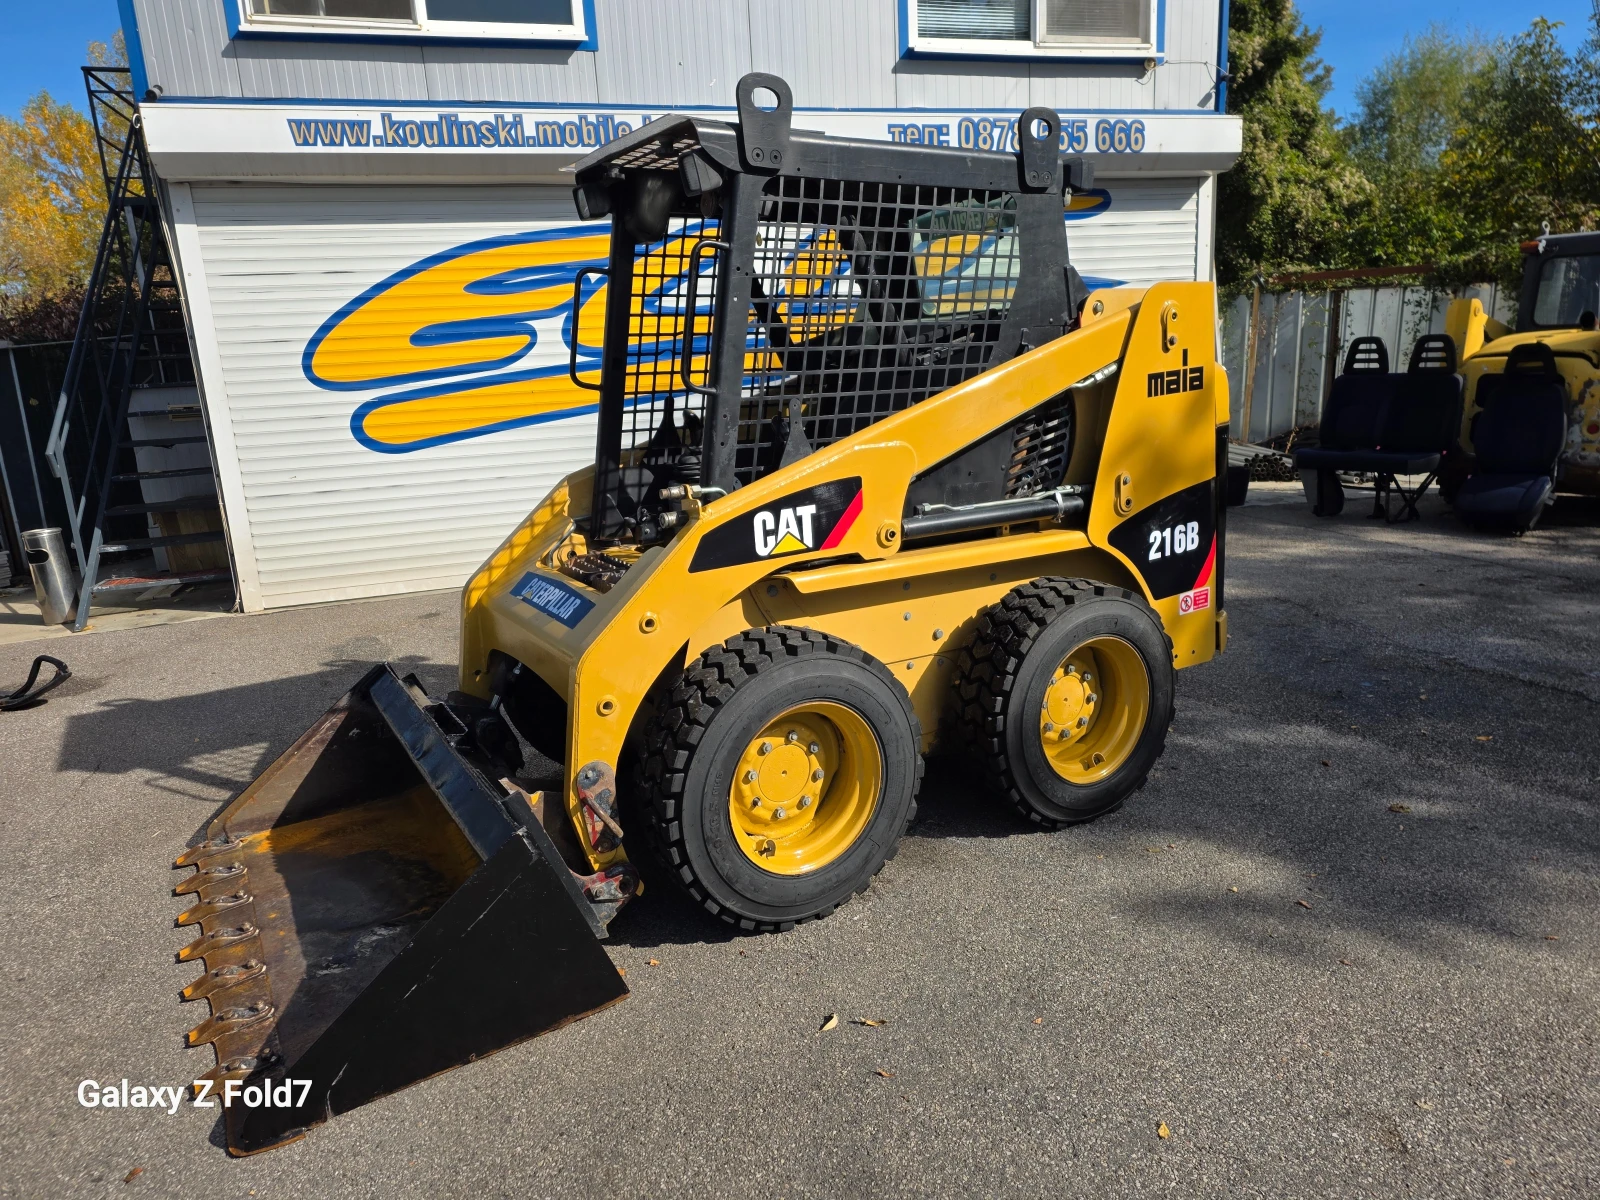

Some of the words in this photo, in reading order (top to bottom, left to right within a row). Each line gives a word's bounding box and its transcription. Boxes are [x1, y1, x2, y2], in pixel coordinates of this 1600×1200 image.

[287, 113, 653, 148] www.koulinski.mobile
[1095, 119, 1145, 153] 666
[753, 504, 817, 557] CAT
[1148, 521, 1200, 561] 216B
[521, 577, 582, 620] CATERPILLAR
